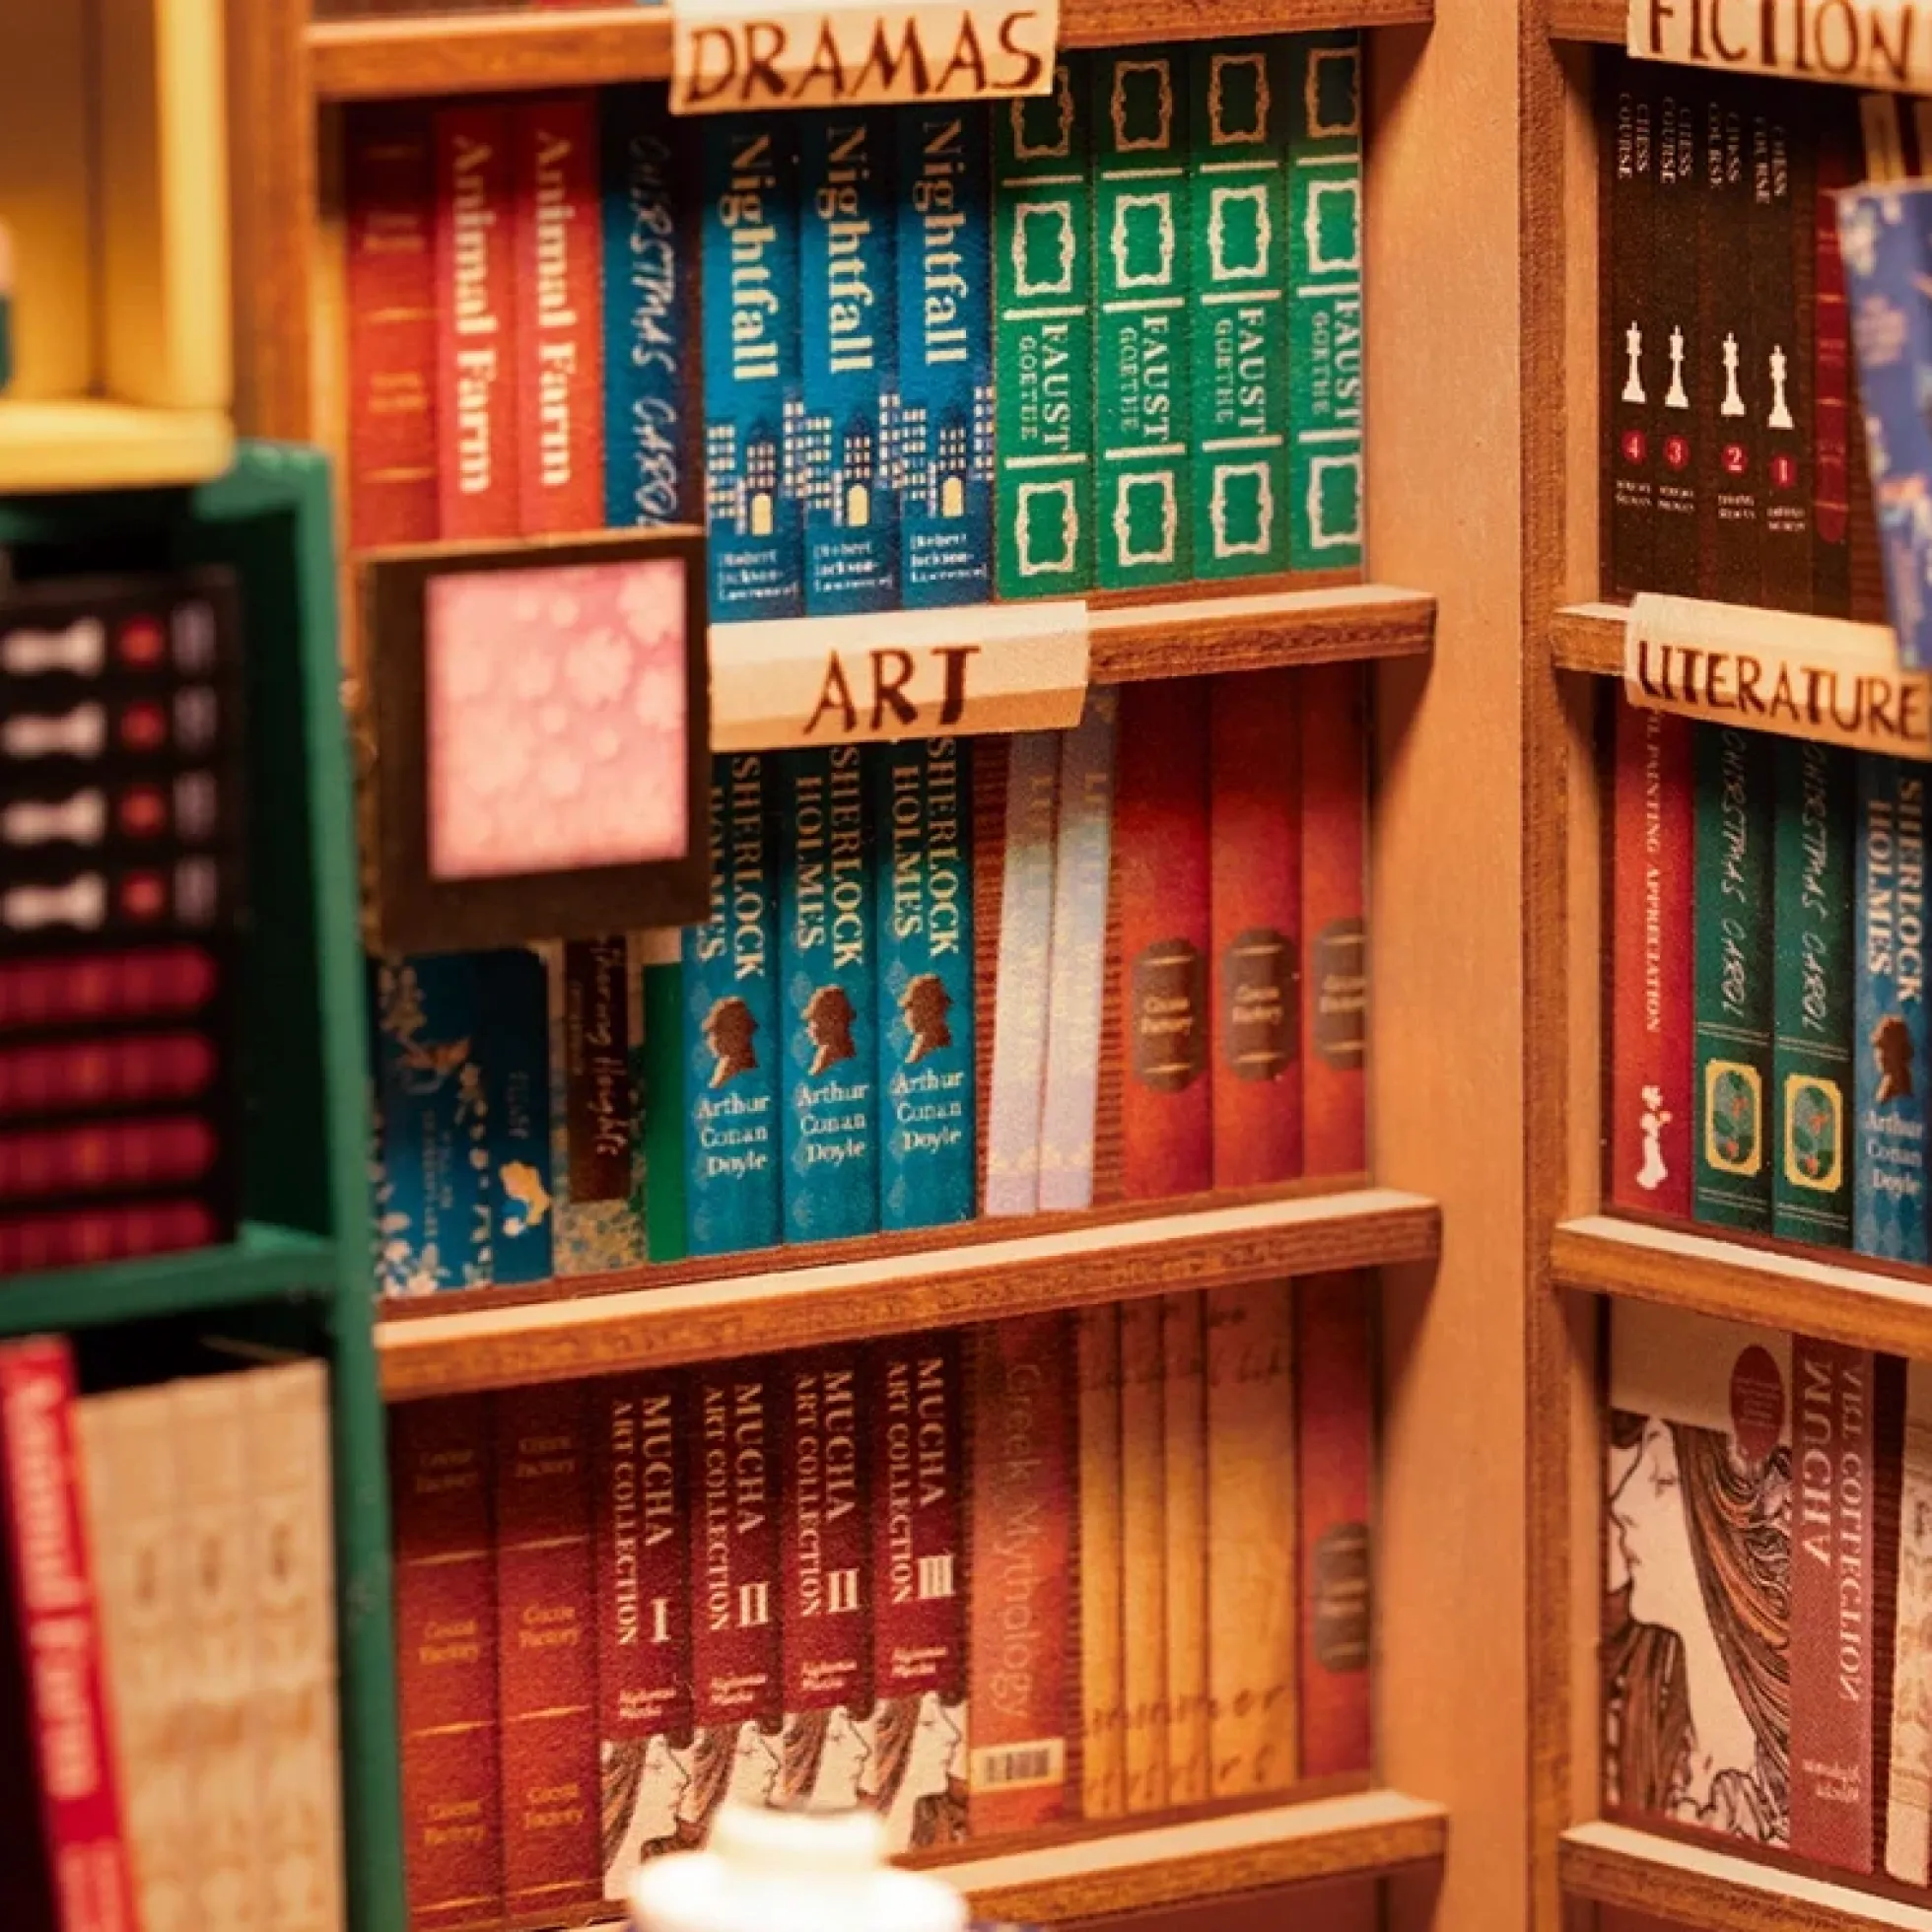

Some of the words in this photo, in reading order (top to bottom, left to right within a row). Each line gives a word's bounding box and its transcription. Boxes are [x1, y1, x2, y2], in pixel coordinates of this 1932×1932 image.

[686, 10, 1043, 103] DRAMAS
[1646, 0, 1910, 81] FICTION
[451, 134, 498, 335] Animal
[536, 131, 577, 329] Animal
[719, 134, 778, 381] Nightfall
[816, 126, 874, 375] Nightfall
[913, 119, 967, 365] Nightfall
[456, 349, 497, 494] Farm
[538, 340, 577, 487] Farm
[1042, 323, 1070, 450] FAUST
[1142, 314, 1170, 443] FAUST
[1238, 308, 1267, 435] FAUST
[1334, 300, 1362, 428] FAUST
[803, 646, 979, 734] ART
[1637, 641, 1929, 740] LITERATURE
[732, 756, 764, 979] SHERLOCK
[795, 776, 825, 949] HOLMES
[830, 746, 863, 969] SHERLOCK
[892, 764, 923, 939] HOLMES
[928, 736, 960, 956] SHERLOCK
[1866, 800, 1894, 976] HOLMES
[1896, 781, 1924, 1004] SHERLOCK
[1645, 865, 1662, 1031] APPRECIATION
[696, 1090, 770, 1119] Arthur
[701, 1128, 768, 1147] Conan
[795, 1080, 869, 1107] Arthur
[800, 1113, 866, 1136] Conan
[806, 1138, 865, 1167] Doyle
[890, 1068, 964, 1094] Arthur
[896, 1101, 962, 1124] Conan
[903, 1126, 961, 1153] Doyle
[707, 1150, 768, 1179] Doyle
[612, 1401, 635, 1453] ART
[704, 1387, 726, 1440] ART
[795, 1374, 818, 1426] ART
[823, 1370, 858, 1523] MUCHA
[887, 1360, 911, 1413] ART
[918, 1357, 946, 1506] MUCHA
[1006, 1361, 1042, 1482] Greek
[642, 1394, 673, 1549] MUCHA
[734, 1383, 766, 1536] MUCHA
[797, 1435, 822, 1617] COLLECTION
[887, 1421, 914, 1606] COLLECTION
[615, 1462, 639, 1646] COLLECTION
[706, 1449, 730, 1631] COLLECTION
[992, 1503, 1042, 1718] Mythology
[651, 1599, 670, 1643] I
